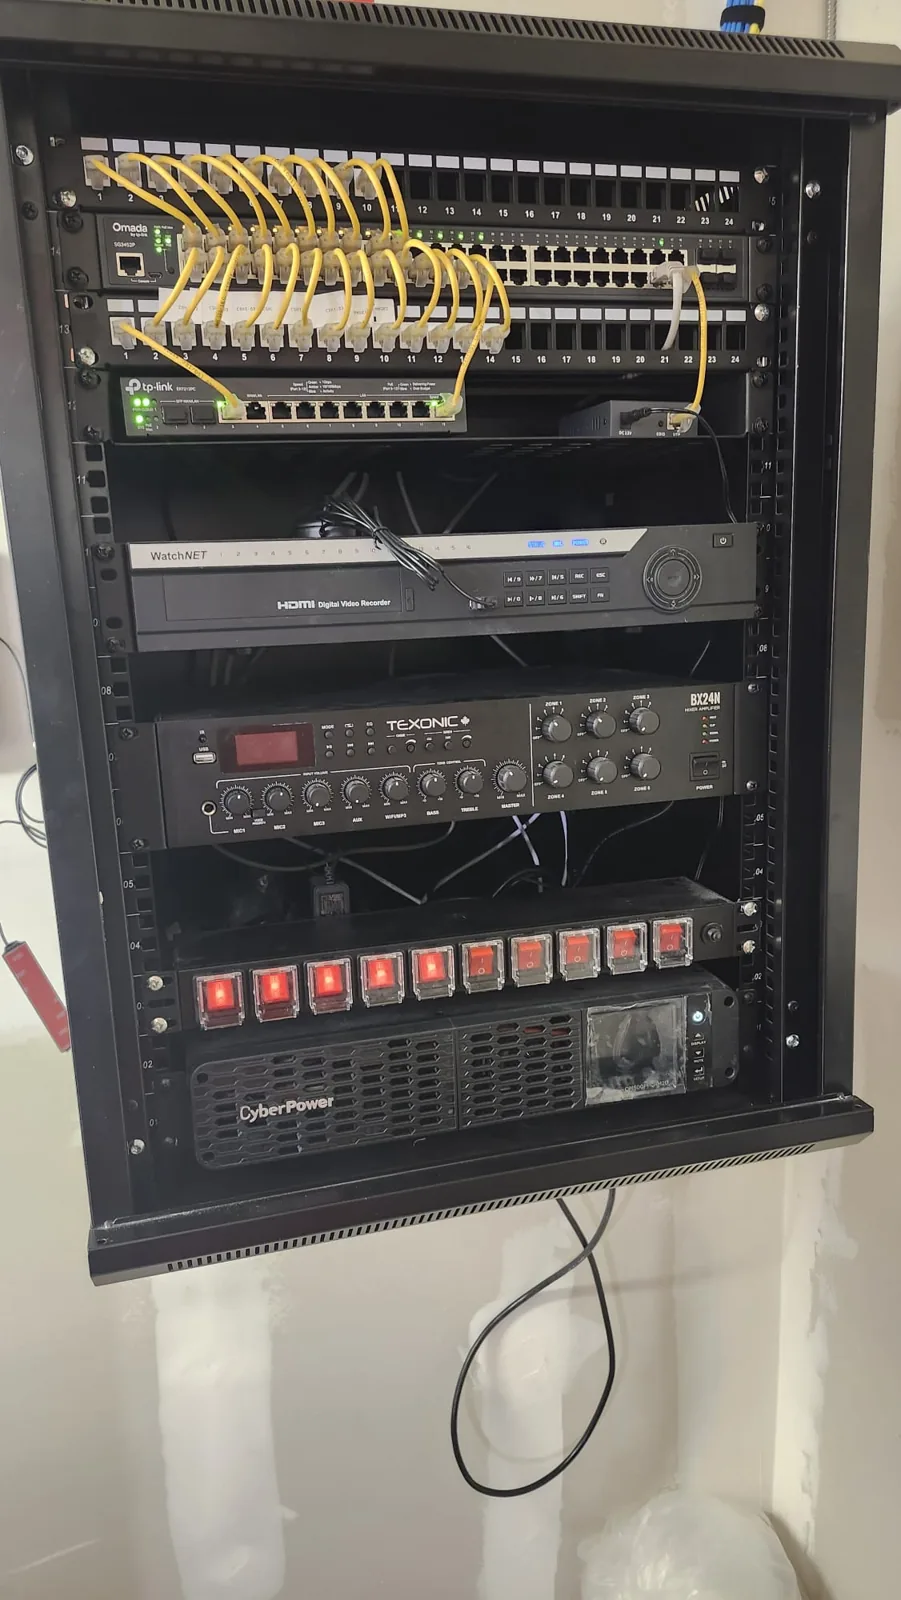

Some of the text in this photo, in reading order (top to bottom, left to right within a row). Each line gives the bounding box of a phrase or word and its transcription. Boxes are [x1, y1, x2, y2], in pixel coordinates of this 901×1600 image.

[98, 193, 102, 201] 1
[128, 194, 134, 202] 2
[362, 204, 372, 212] 10
[418, 206, 427, 214] 12
[445, 207, 454, 215] 13
[472, 208, 481, 216] 14
[499, 209, 508, 217] 15
[525, 210, 534, 218] 16
[551, 211, 560, 219] 17
[577, 212, 586, 220] 18
[602, 213, 611, 221] 19
[627, 214, 636, 222] 20
[652, 215, 661, 223] 21
[677, 216, 686, 224] 22
[701, 217, 710, 225] 23
[725, 218, 734, 226] 24
[112, 222, 148, 233] Omada
[50, 246, 61, 256] 14
[59, 324, 70, 335] 13
[123, 352, 129, 360] 1
[153, 352, 159, 360] 2
[183, 353, 188, 361] 3
[212, 353, 218, 361] 4
[242, 353, 247, 361] 5
[270, 354, 276, 362] 6
[299, 354, 304, 362] 7
[327, 354, 332, 363] 8
[354, 355, 360, 363] 9
[380, 355, 390, 363] 10
[407, 355, 416, 363] 11
[433, 356, 443, 364] 12
[485, 356, 495, 364] 14
[511, 355, 521, 363] 15
[537, 356, 546, 364] 16
[562, 356, 571, 364] 17
[587, 356, 596, 364] 18
[611, 356, 621, 364] 19
[635, 356, 645, 364] 20
[660, 356, 669, 364] 21
[684, 356, 693, 364] 22
[708, 356, 716, 364] 23
[731, 356, 740, 364] 24
[142, 381, 174, 393] tp-link
[764, 461, 772, 470] 11
[77, 475, 88, 485] 11
[150, 550, 208, 561] WatchNET
[277, 598, 391, 610] HDMI Digital Video Recorder
[101, 684, 113, 696] 08
[690, 691, 721, 706] BX24N
[386, 715, 459, 731] TEXONIC
[123, 879, 135, 889] 05
[130, 940, 140, 950] 04
[142, 1059, 153, 1070] 02
[239, 1096, 335, 1123] CyberPower
